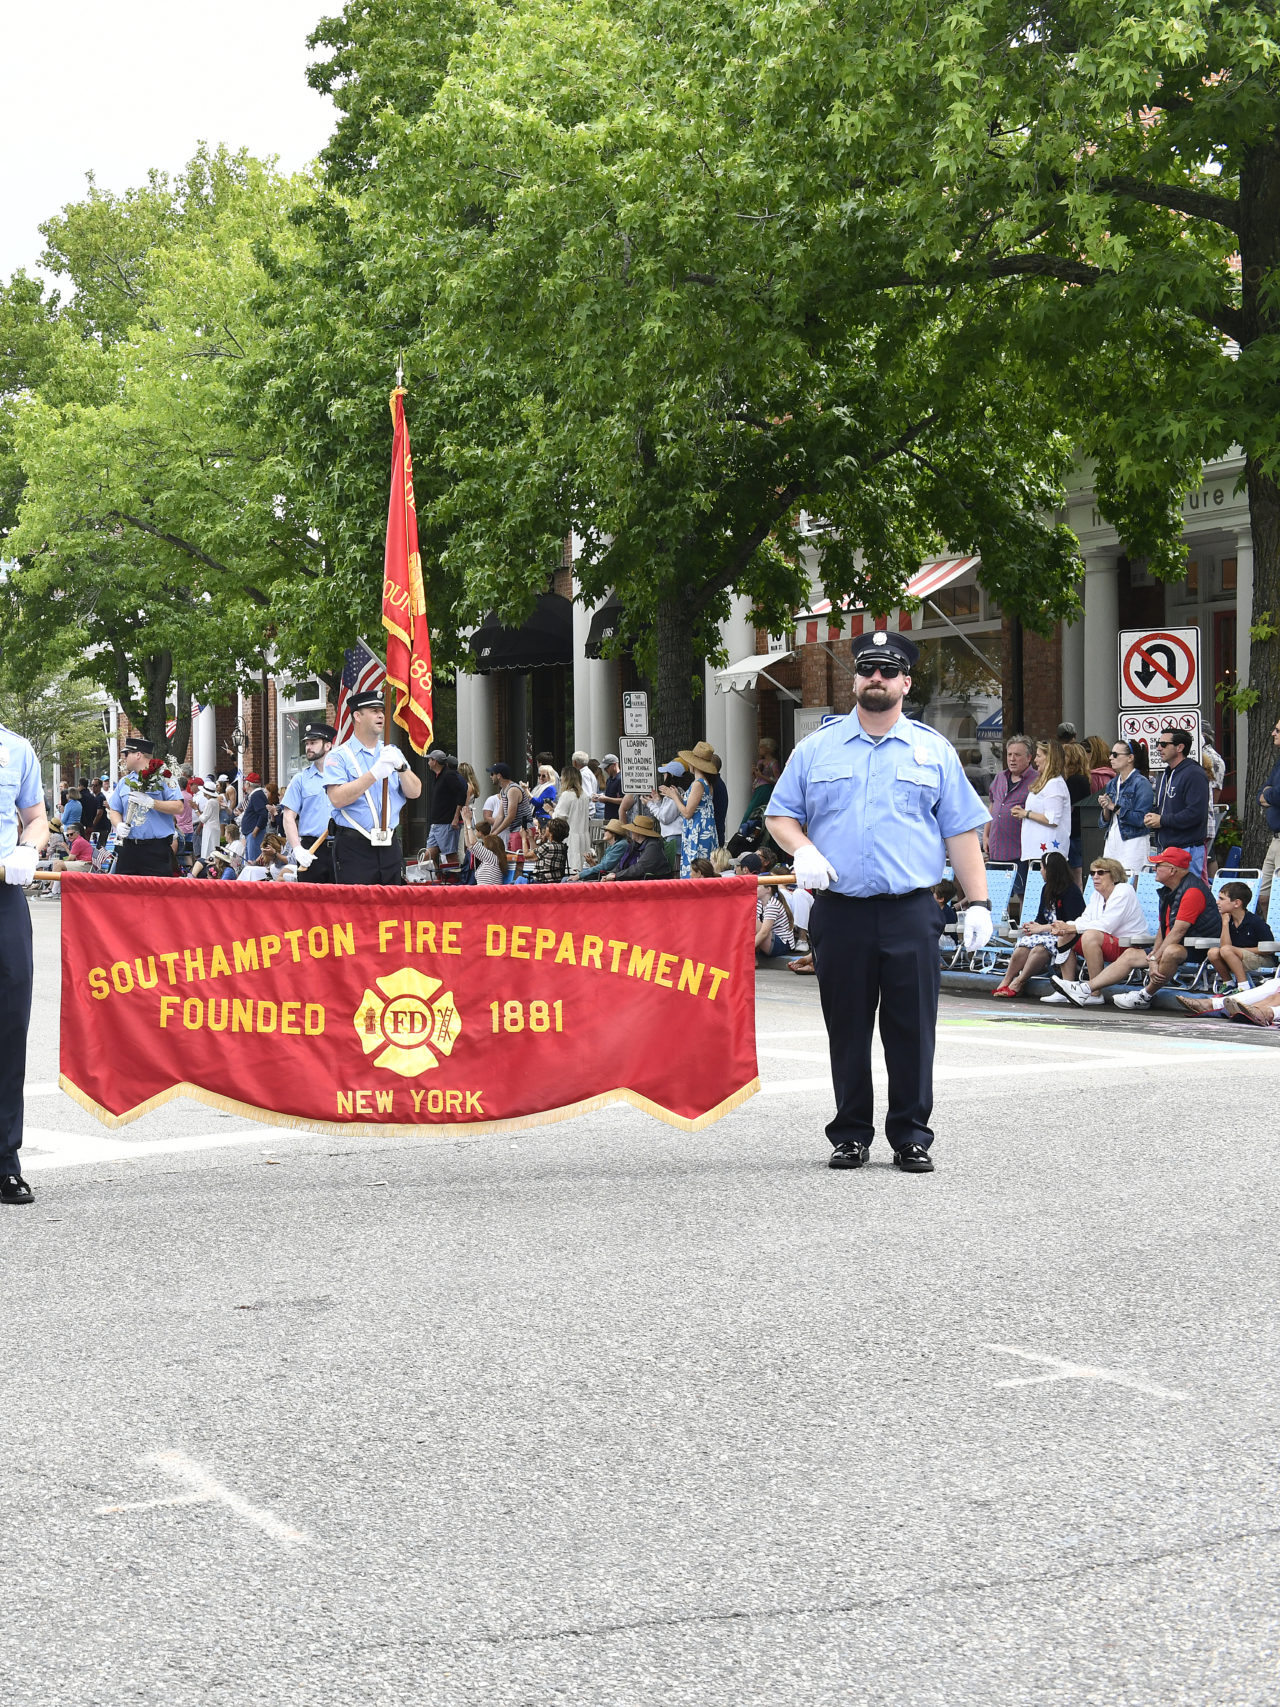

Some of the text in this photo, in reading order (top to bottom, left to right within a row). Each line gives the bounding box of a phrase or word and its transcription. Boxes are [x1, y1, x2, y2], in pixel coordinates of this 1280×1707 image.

[625, 696, 631, 706] 2
[626, 740, 648, 748] LOADING
[634, 748, 642, 756] OR
[89, 919, 730, 1001] SOUTHAMPTON FIRE DEPARTMENT
[159, 995, 326, 1036] FOUNDED
[389, 1010, 428, 1034] FD
[489, 999, 564, 1033] 1881
[335, 1089, 485, 1115] NEW YORK
